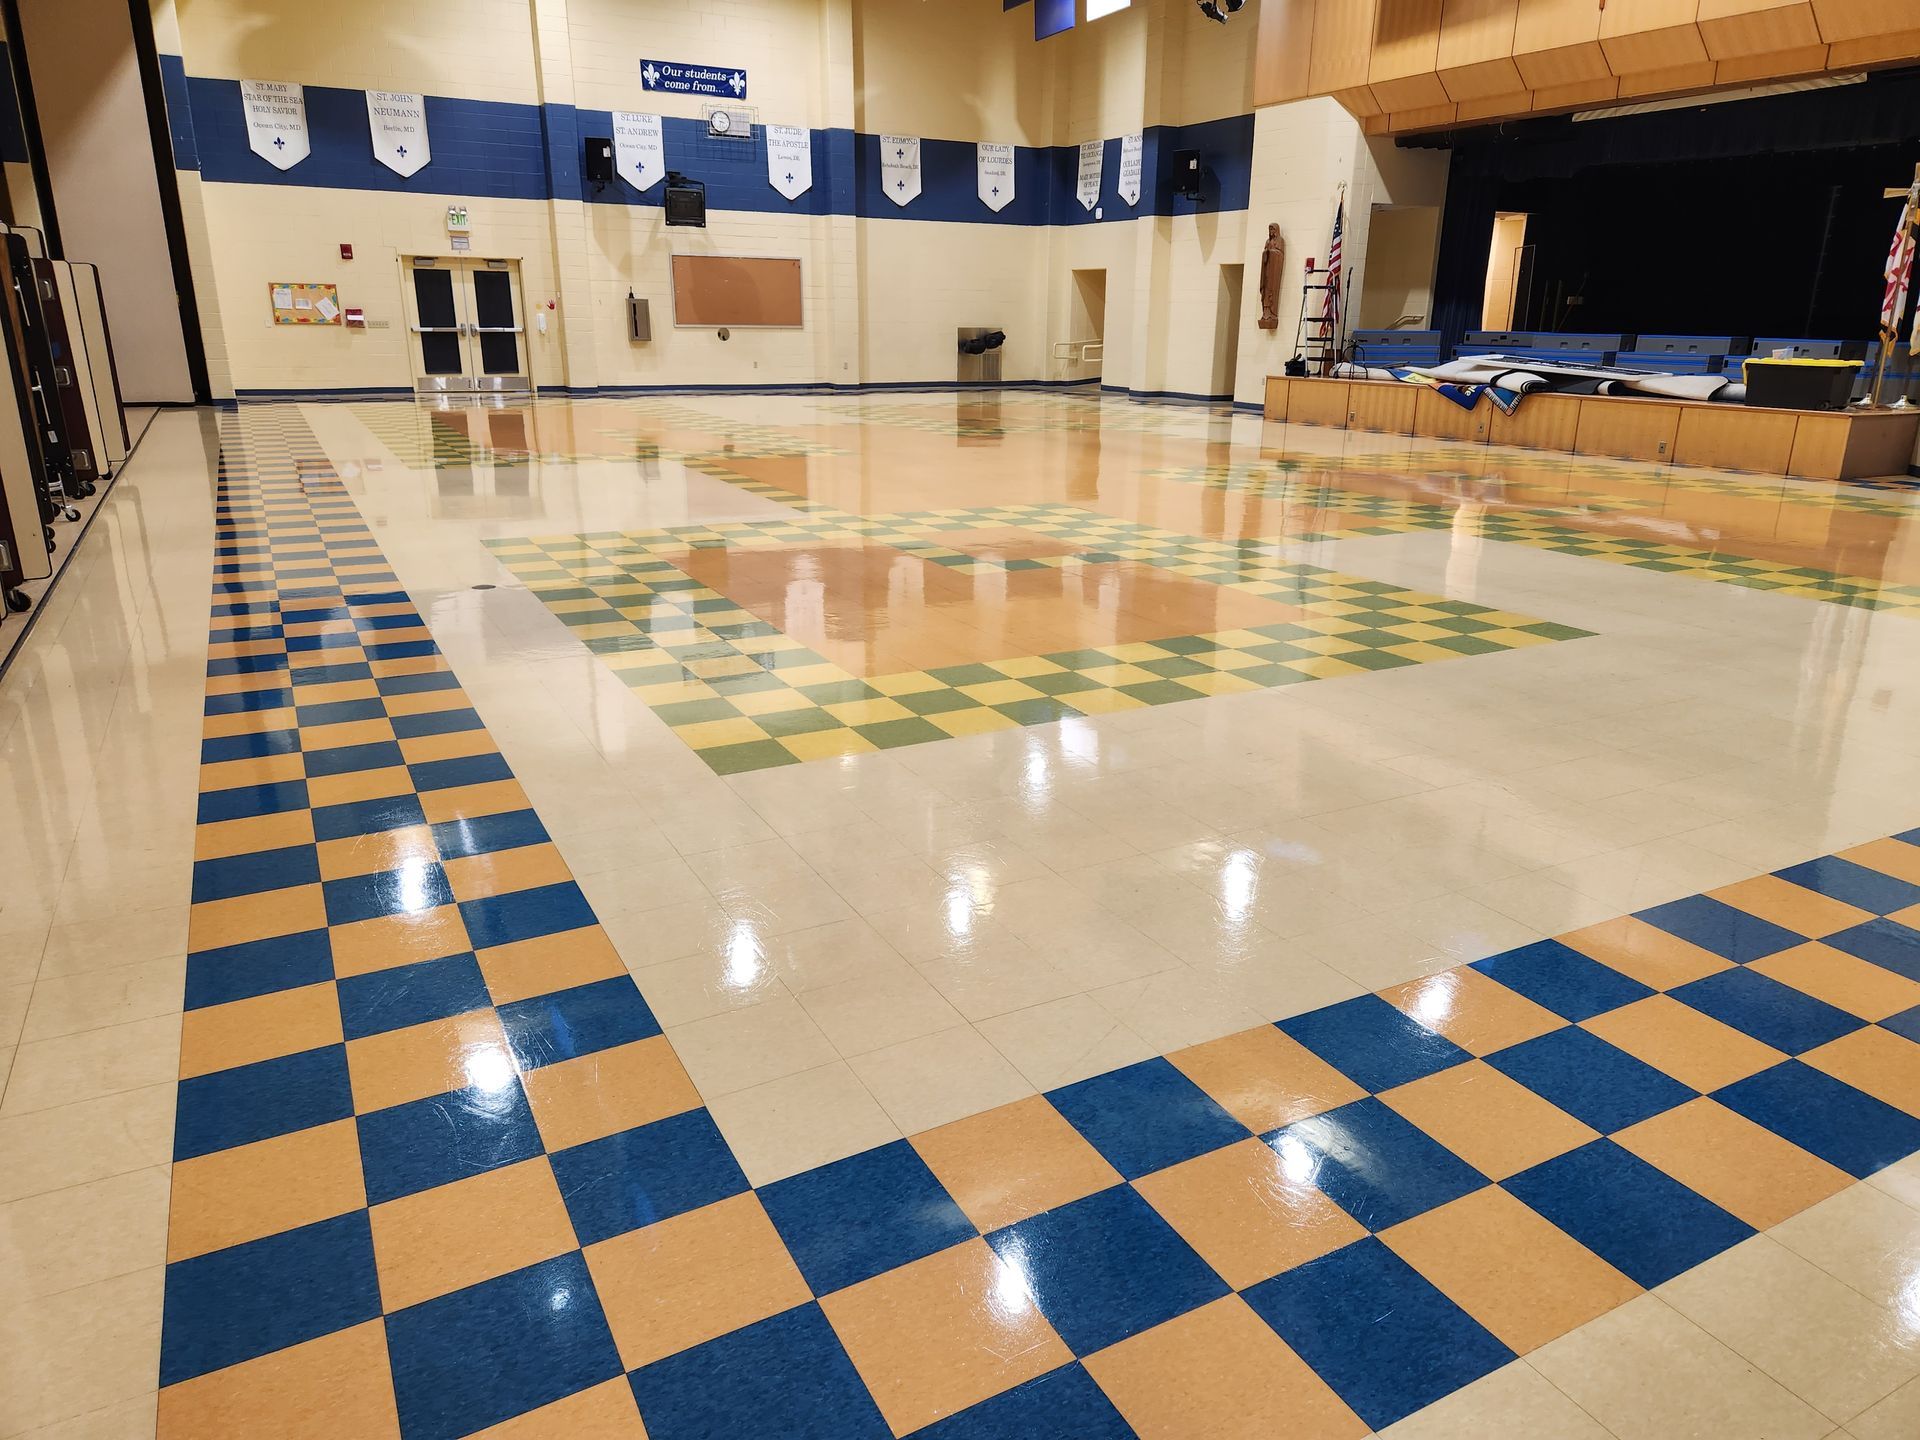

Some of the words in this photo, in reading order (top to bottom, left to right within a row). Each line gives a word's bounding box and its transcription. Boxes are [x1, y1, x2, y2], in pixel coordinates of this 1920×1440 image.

[662, 65, 683, 77] Our
[684, 69, 727, 82] students
[266, 83, 288, 93] MARY
[664, 80, 690, 91] come
[691, 80, 725, 94] from...
[243, 93, 262, 102] STAR
[262, 94, 272, 103] OF
[272, 95, 289, 104] THE
[288, 97, 304, 105] SEA
[389, 94, 414, 103] JOHN
[252, 105, 272, 114] HOLY
[272, 106, 298, 116] SAVIOR
[373, 107, 420, 118] NEUMANN
[632, 114, 653, 124] LUKE
[253, 121, 274, 129] Ocean
[628, 127, 659, 137] ANDREW
[784, 127, 802, 136] JUDE
[768, 138, 782, 147] THE
[782, 140, 809, 149] APOSTLE
[892, 137, 918, 145] EDMOND
[979, 155, 987, 163] OF
[987, 156, 1013, 165] LOURDES
[452, 214, 467, 226] EXIT
